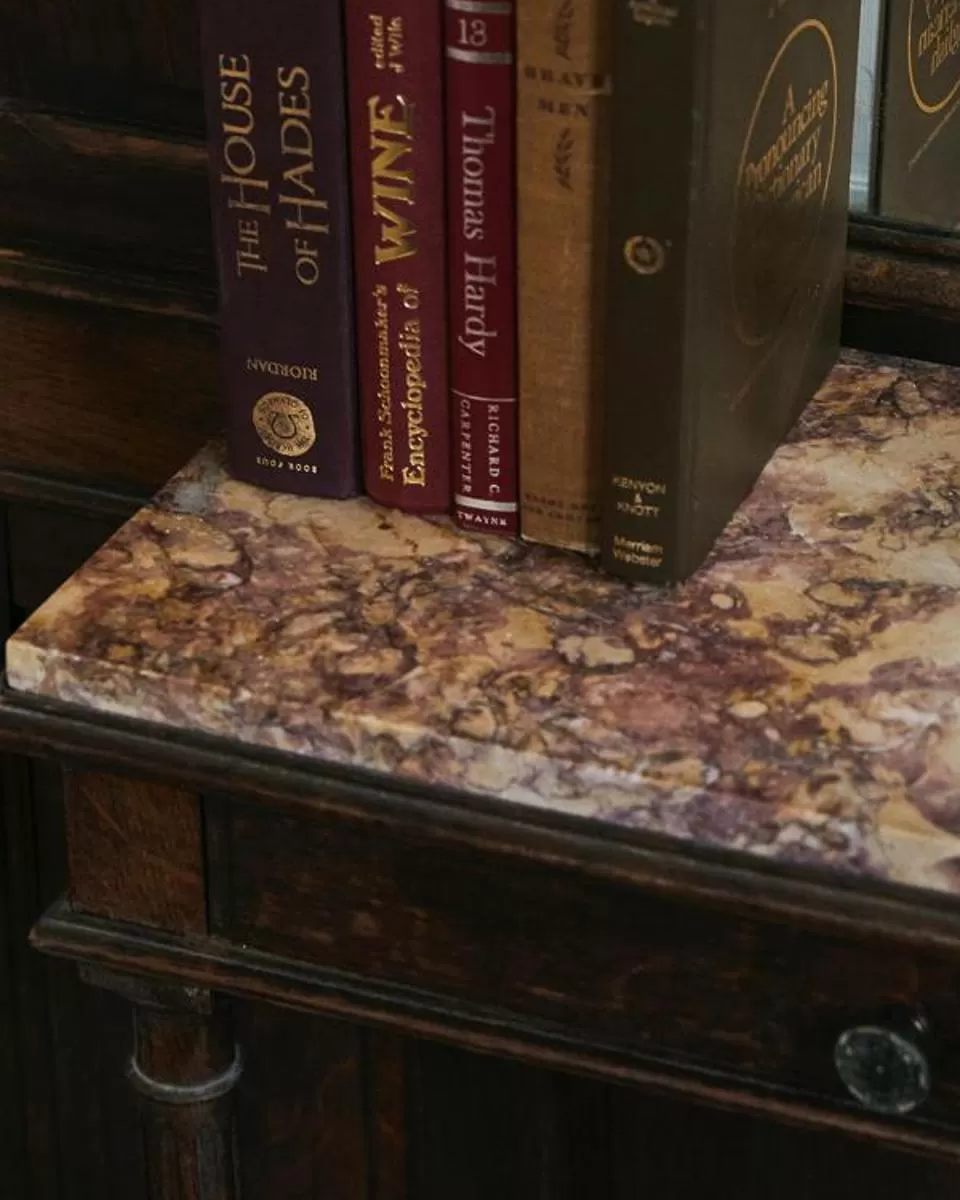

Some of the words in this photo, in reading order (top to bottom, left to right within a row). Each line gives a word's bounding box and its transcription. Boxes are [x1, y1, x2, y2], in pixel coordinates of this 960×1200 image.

[218, 53, 271, 216] HOUSE
[276, 65, 329, 234] HADES
[460, 106, 496, 241] Thomas
[367, 94, 418, 266] WINE
[236, 218, 269, 277] THE
[293, 238, 320, 286] OF
[396, 282, 420, 310] of
[457, 251, 498, 358] Hardy
[246, 357, 319, 382] RIORDAN
[398, 319, 428, 487] Encyclopedia
[378, 427, 395, 482] Frank
[459, 399, 473, 493] CARPENTER
[487, 403, 501, 478] RICHARD
[456, 510, 508, 527] TWAYNE
